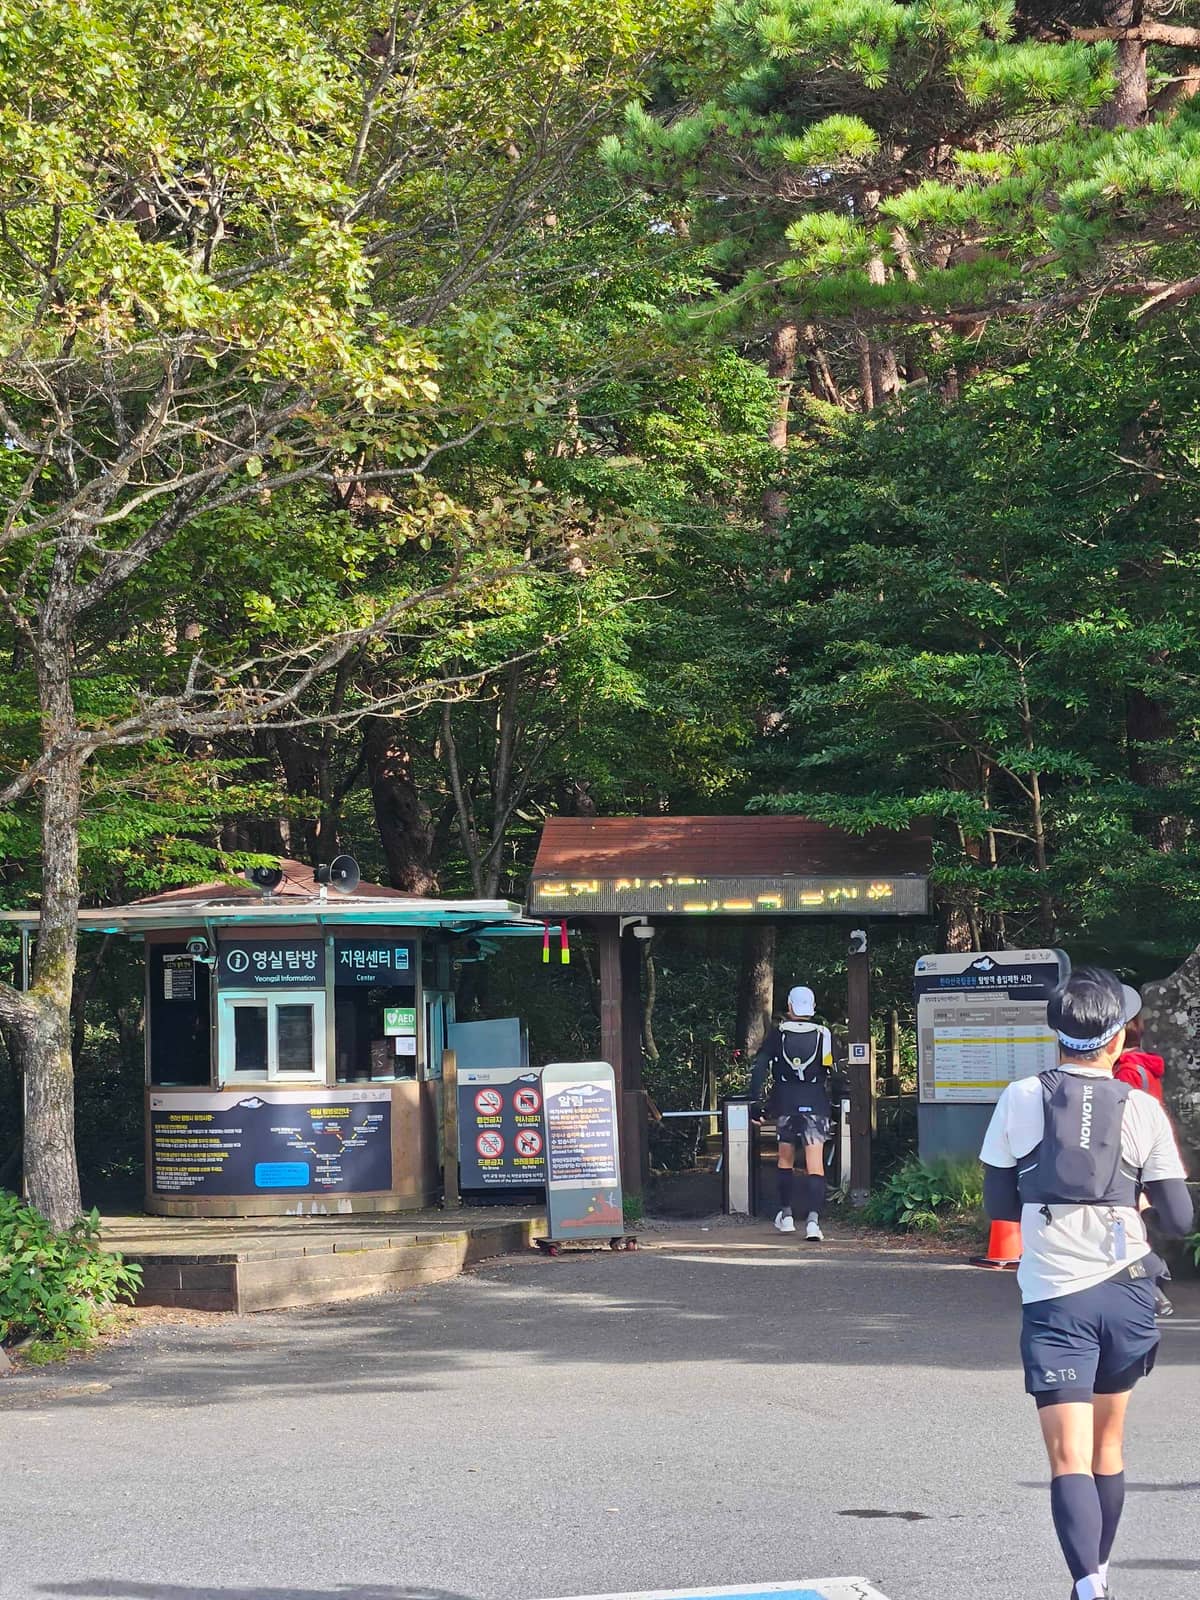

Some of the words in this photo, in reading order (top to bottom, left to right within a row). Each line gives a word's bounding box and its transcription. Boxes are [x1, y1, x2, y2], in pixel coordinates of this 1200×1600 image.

[252, 950, 283, 970] 영실
[285, 950, 318, 970] 탐방
[340, 950, 391, 968] 지원센터
[254, 974, 280, 984] Yeongsil
[281, 974, 316, 983] Information
[356, 974, 376, 982] Center
[1020, 974, 1032, 983] 시간
[398, 1014, 415, 1024] AED
[1079, 1085, 1094, 1149] SALOMON
[1057, 1368, 1077, 1382] T8
